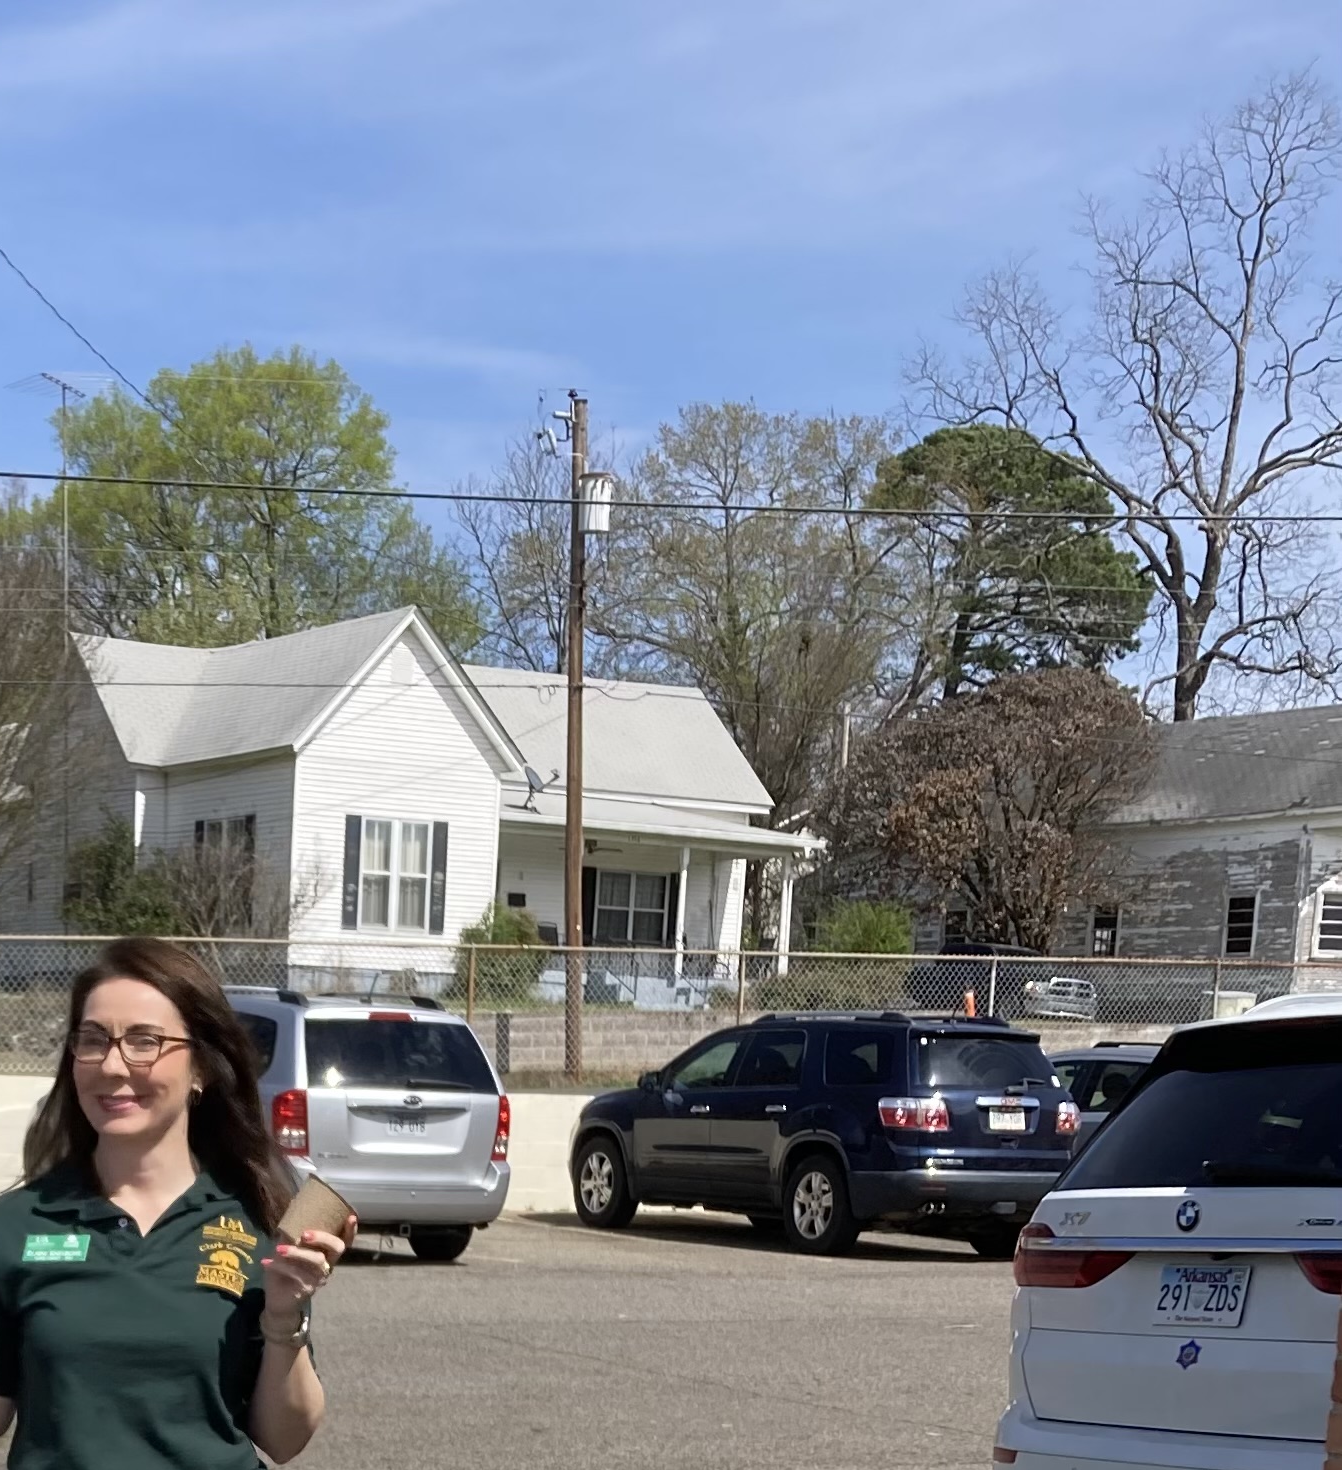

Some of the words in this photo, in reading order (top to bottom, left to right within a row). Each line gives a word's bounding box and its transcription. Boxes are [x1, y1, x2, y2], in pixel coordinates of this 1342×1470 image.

[1059, 1211, 1091, 1226] X7
[1178, 1267, 1230, 1283] Arkansas
[1157, 1284, 1192, 1311] 291
[1203, 1284, 1241, 1312] ZDS
